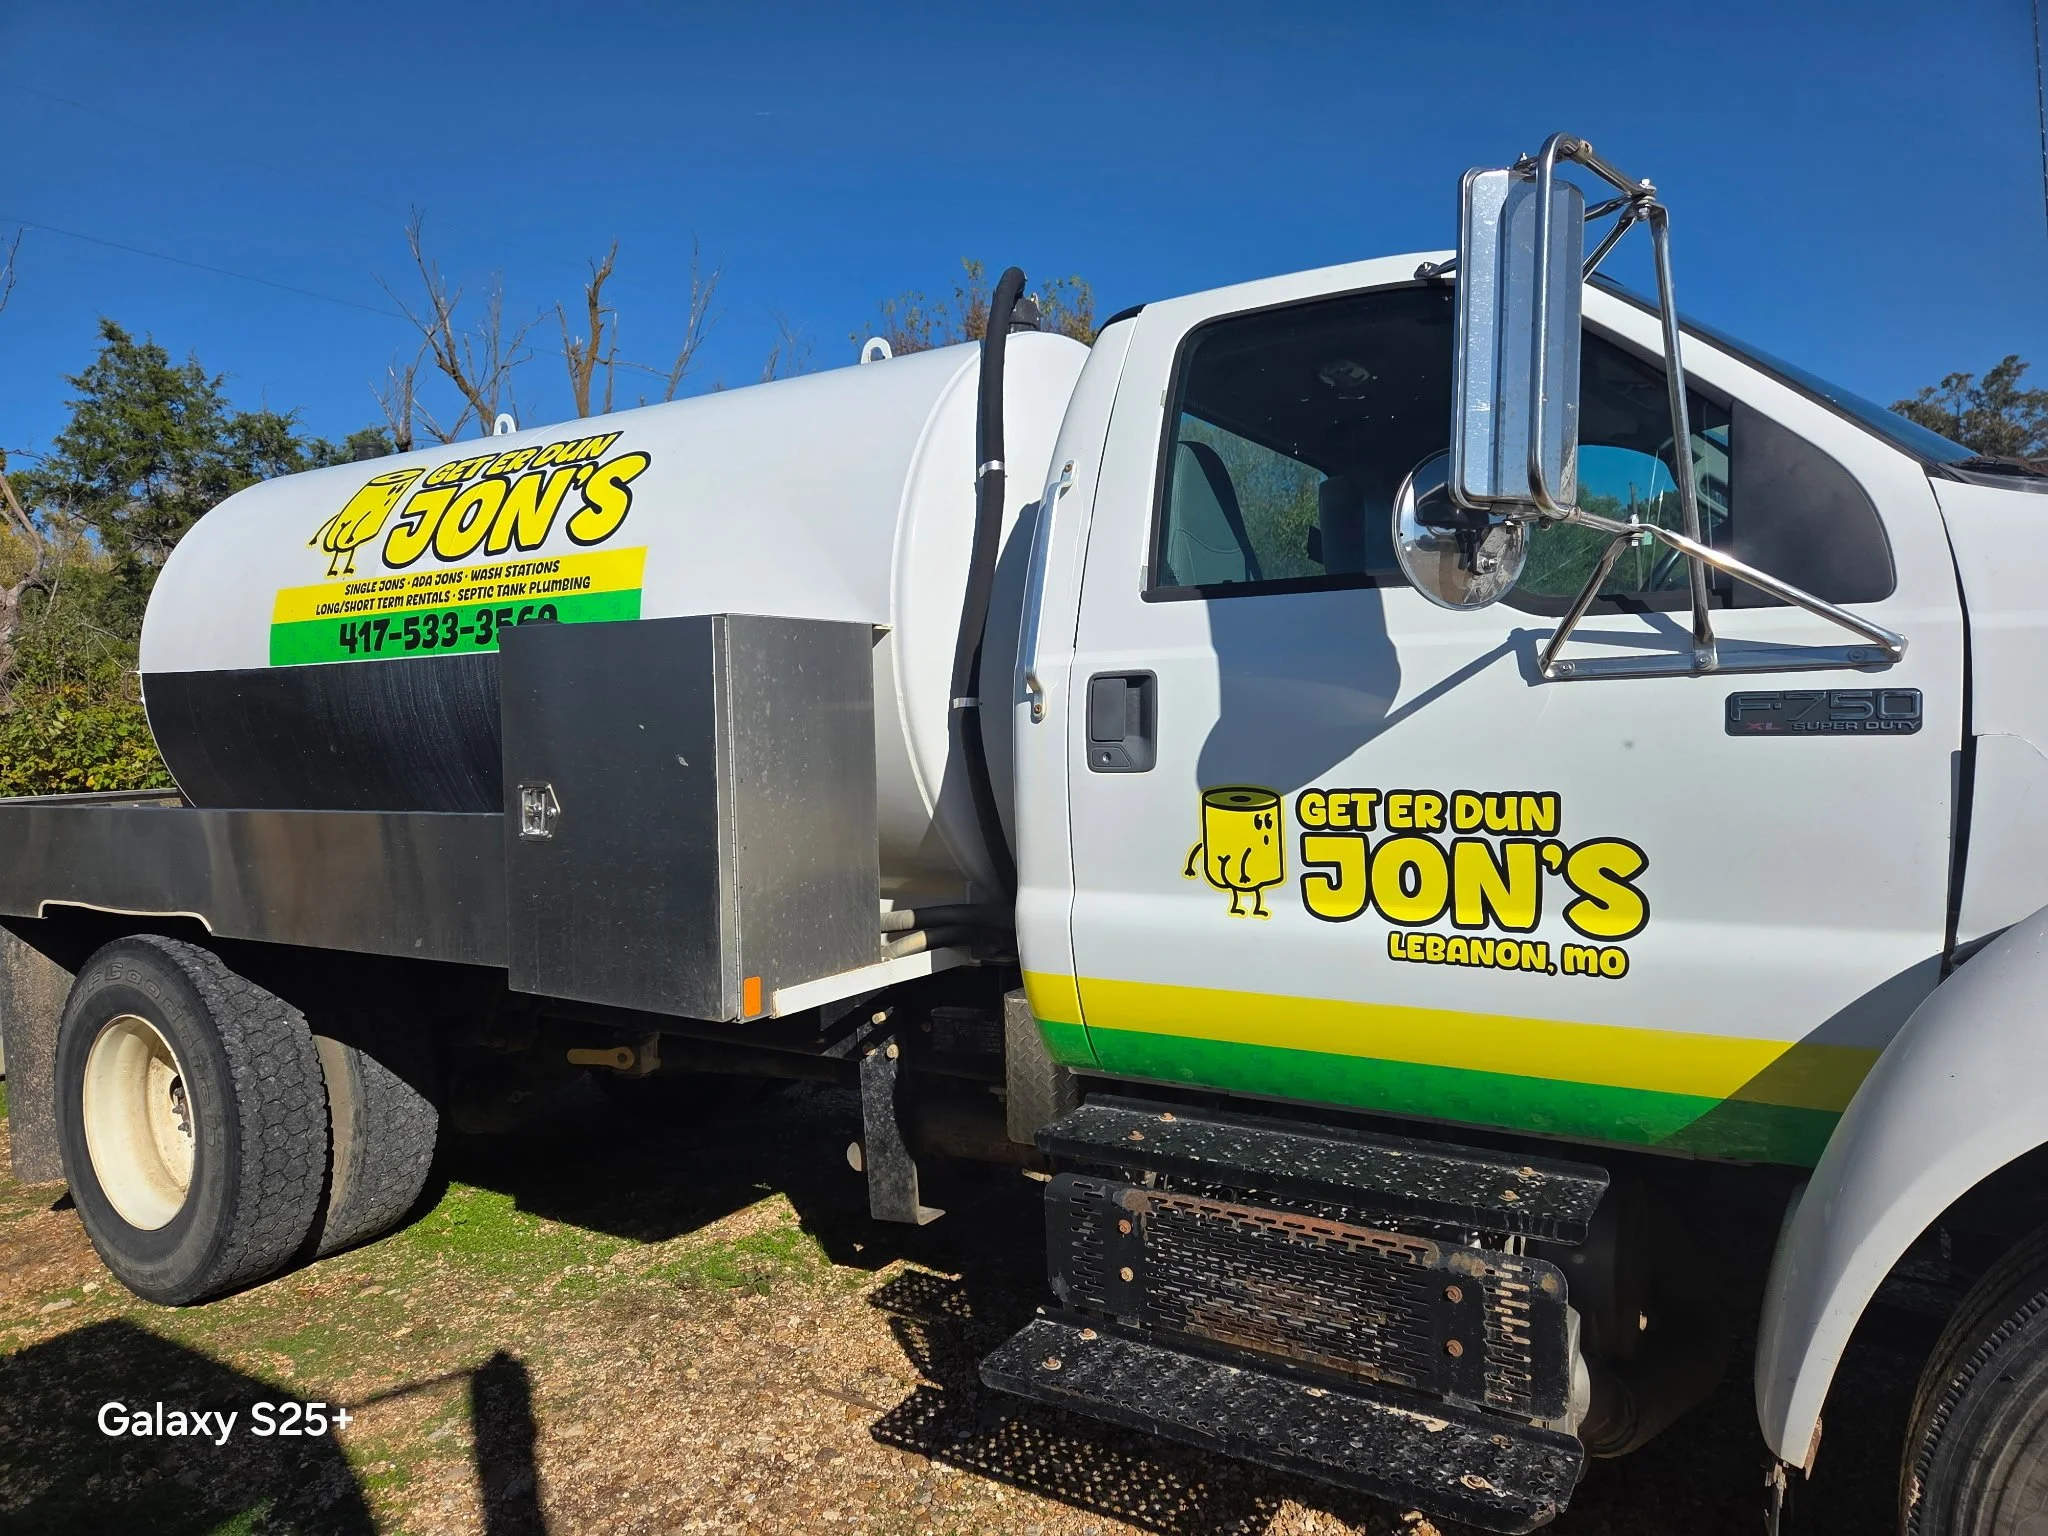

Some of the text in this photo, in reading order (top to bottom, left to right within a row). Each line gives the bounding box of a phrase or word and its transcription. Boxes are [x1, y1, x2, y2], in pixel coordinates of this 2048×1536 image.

[424, 432, 621, 486] GET ER DUN
[382, 451, 651, 569] JON'S
[316, 597, 375, 615] LONG/SHORT
[406, 590, 450, 606] RENTALS
[458, 585, 494, 601] SEPTIC
[497, 581, 526, 597] TANK
[345, 560, 560, 595] SINGLE JONS ADA JONS WASH STATIONS
[1745, 720, 1921, 731] XL SUPER DUTY
[1298, 790, 1559, 835] GET ER DUN
[1301, 833, 1649, 941] JON'S
[1389, 933, 1555, 974] LEBANON,
